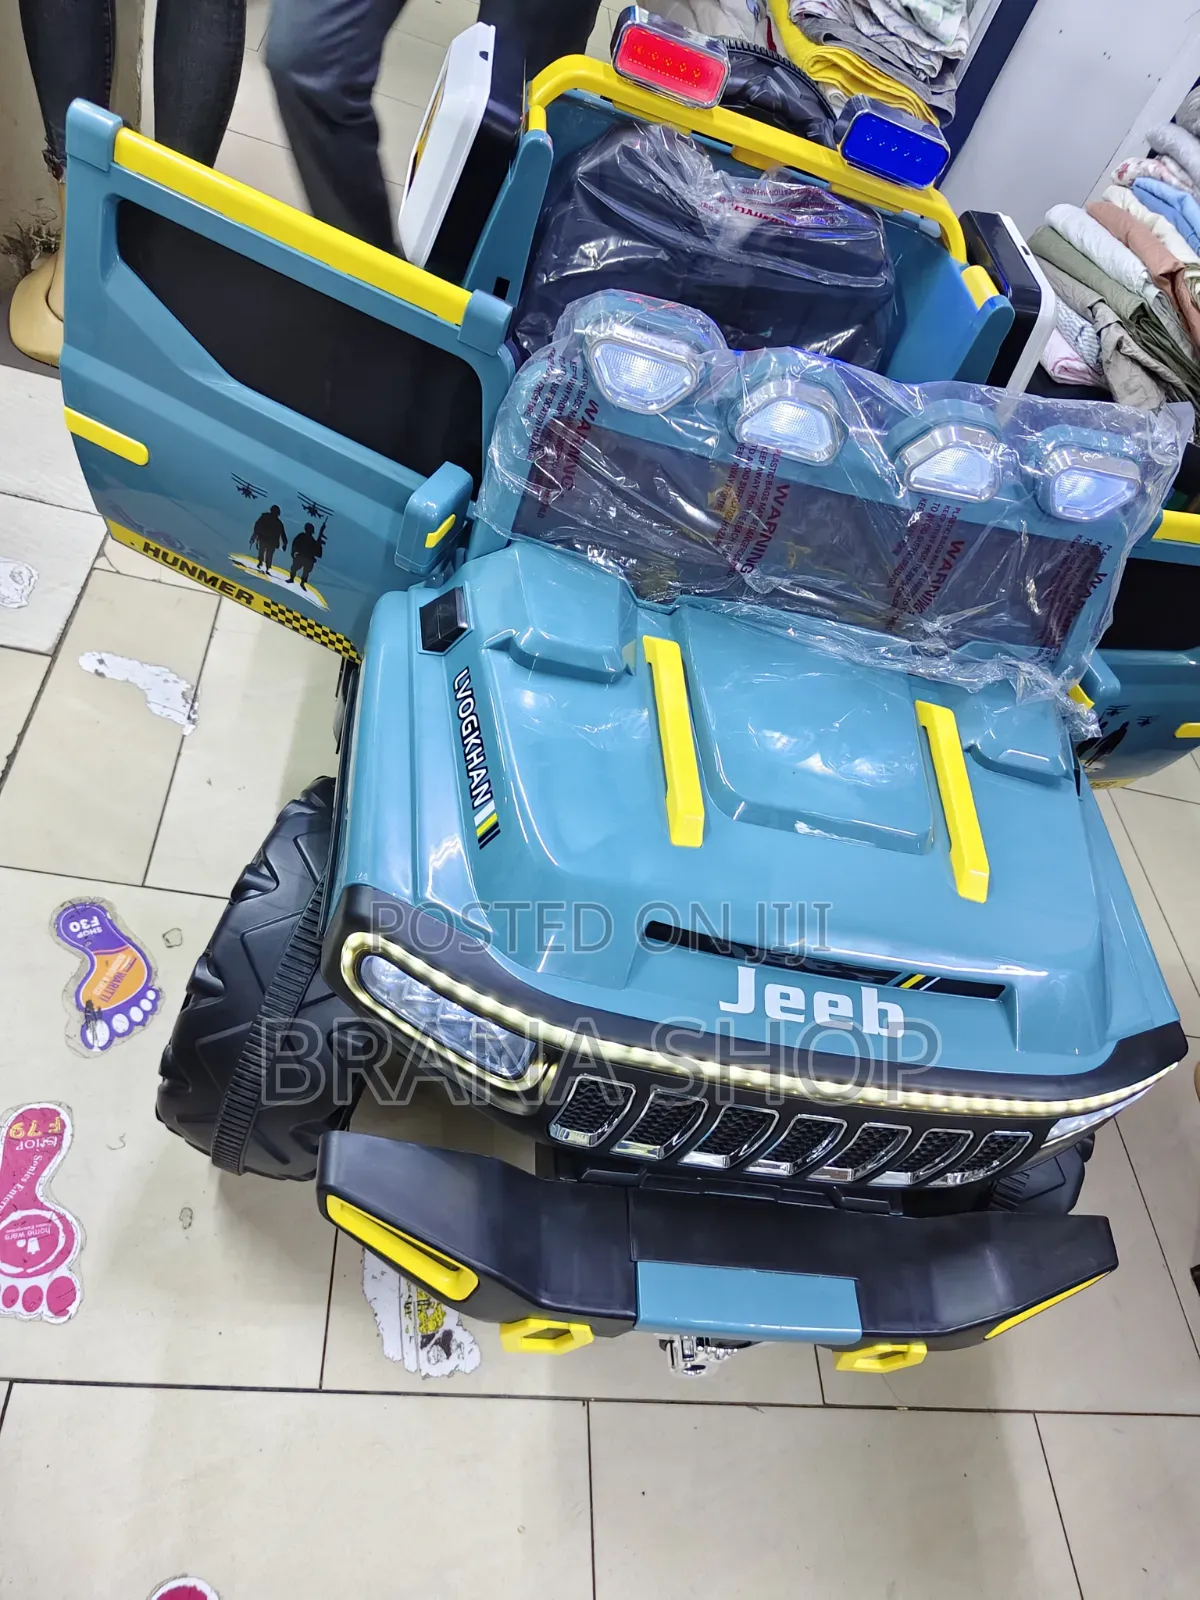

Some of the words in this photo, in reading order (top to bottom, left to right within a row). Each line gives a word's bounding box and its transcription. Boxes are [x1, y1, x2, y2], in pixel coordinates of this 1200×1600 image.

[747, 443, 757, 455] TO
[757, 446, 769, 465] KEEP
[726, 461, 739, 483] AWAY
[740, 455, 754, 480] AVOID
[766, 448, 782, 479] PLASTIC
[751, 466, 764, 489] AWAY
[744, 490, 757, 511] FROM
[760, 480, 772, 501] BAGS
[930, 501, 940, 513] TO
[729, 520, 744, 542] REACH
[739, 484, 790, 575] WARNING
[143, 541, 255, 605] HUNMER
[453, 666, 493, 810] LVOGKHAN
[68, 915, 100, 932] F30
[76, 926, 102, 938] SHOP
[98, 972, 127, 1002] WARITTI
[719, 965, 904, 1037] Jeeb
[26, 1227, 50, 1236] home
